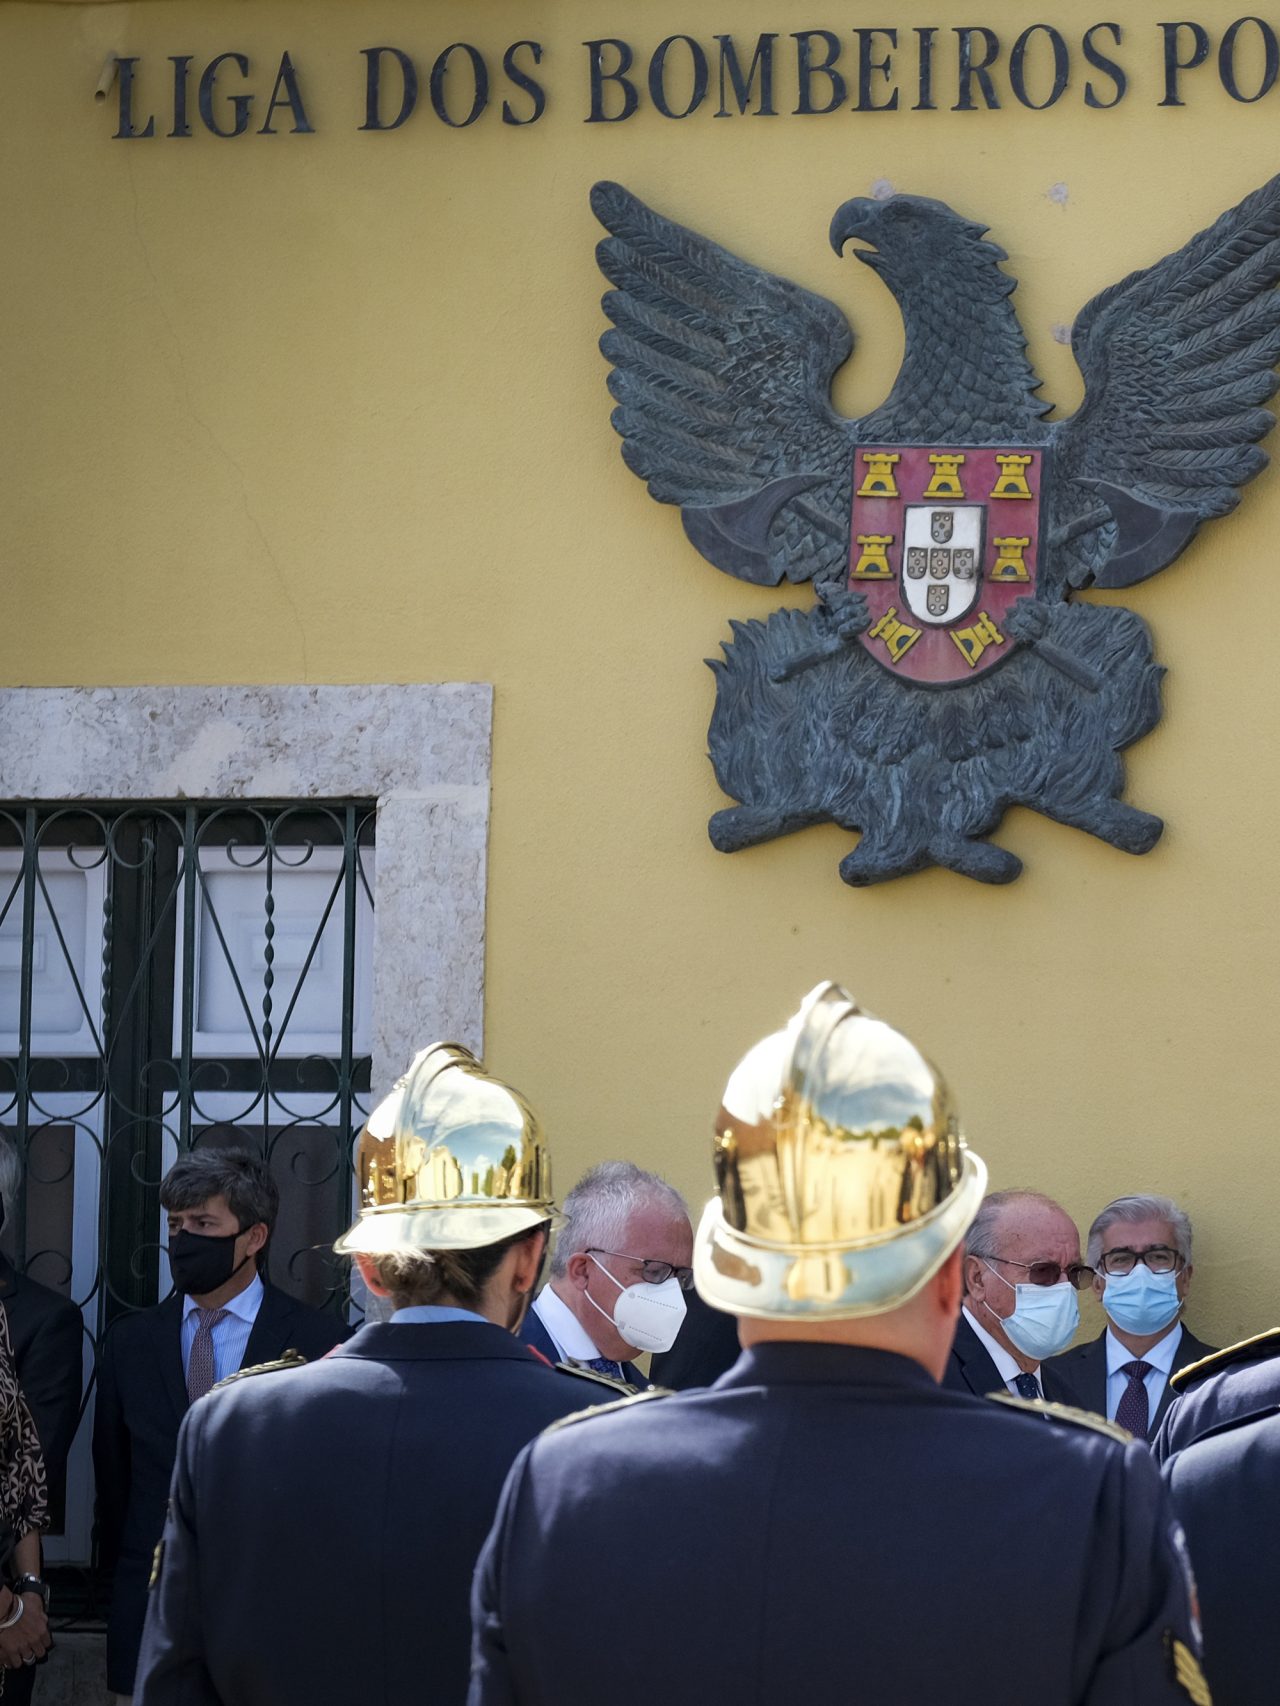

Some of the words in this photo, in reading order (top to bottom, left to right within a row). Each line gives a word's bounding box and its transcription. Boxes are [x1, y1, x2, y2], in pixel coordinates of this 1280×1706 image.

[112, 50, 317, 139] LIGA
[357, 40, 547, 132] DOS
[582, 22, 1127, 123] BOMBEIROS
